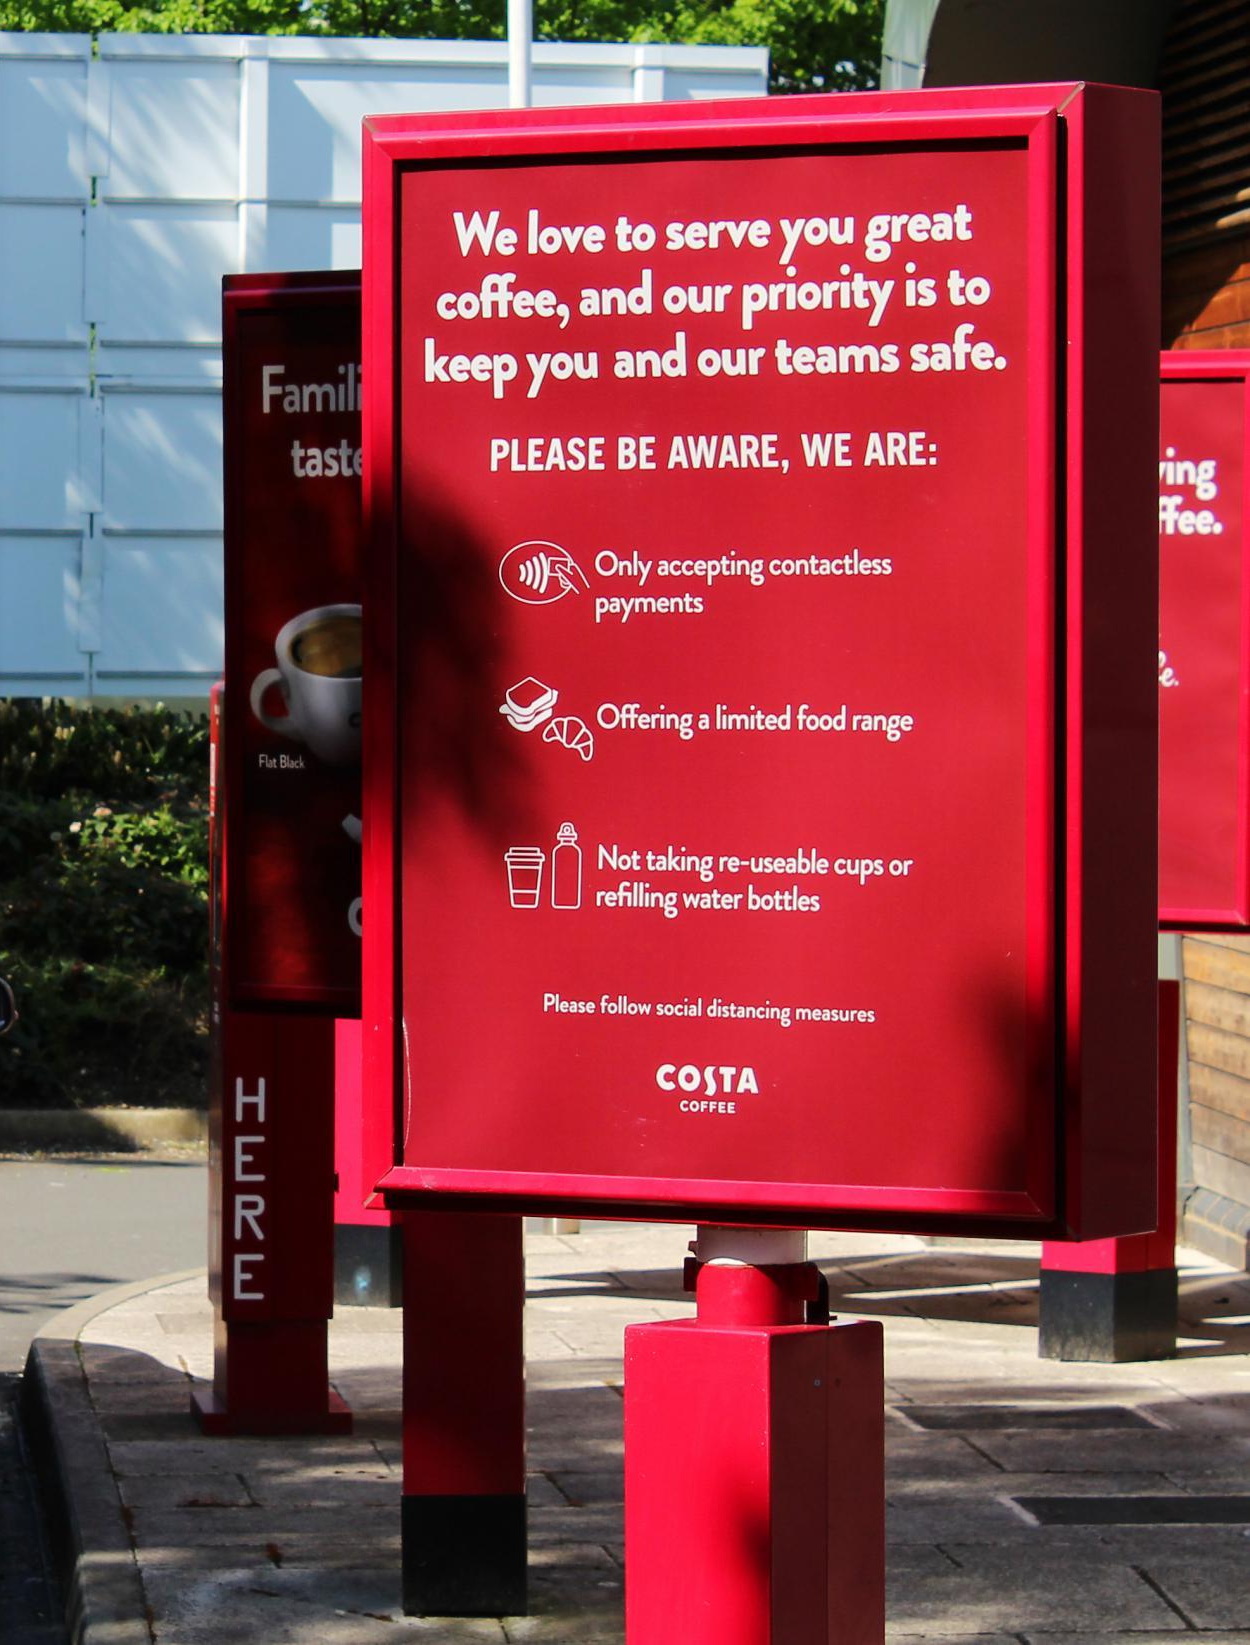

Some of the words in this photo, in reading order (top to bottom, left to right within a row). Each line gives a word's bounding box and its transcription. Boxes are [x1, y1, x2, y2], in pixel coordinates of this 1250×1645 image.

[452, 210, 518, 257] We
[527, 209, 607, 255] love
[614, 216, 657, 252] to
[665, 219, 772, 251] serve
[779, 215, 855, 265] you
[865, 204, 973, 262] great
[436, 272, 570, 329] coffee,
[579, 268, 653, 317] and
[662, 284, 734, 314] our
[742, 265, 895, 330] priority
[904, 261, 938, 307] is
[946, 269, 991, 306] to
[424, 337, 518, 399] keep
[525, 351, 599, 399] you
[613, 331, 687, 379] and
[697, 347, 767, 377] our
[774, 339, 900, 375] teams
[909, 322, 1007, 372] safe.
[490, 437, 606, 472] PLEASE
[617, 436, 657, 470] BE
[667, 434, 790, 474] AWARE,
[800, 432, 853, 467] WE
[863, 431, 937, 467] ARE:
[594, 550, 653, 586] Only
[657, 550, 765, 586] accepting
[768, 548, 893, 576] contactless
[595, 592, 704, 623] payments
[596, 703, 694, 740] Offering
[697, 713, 710, 730] a
[715, 703, 792, 731] limited
[796, 703, 847, 731] food
[852, 714, 914, 742] range
[258, 753, 277, 769] Flat
[280, 754, 306, 769] Black
[597, 843, 641, 871] Not
[645, 845, 714, 883] taking
[718, 847, 830, 875] re-useable
[833, 858, 885, 886] cups
[888, 859, 914, 876] or
[596, 881, 679, 919] refilling
[683, 890, 743, 910] water
[747, 884, 821, 912] bottles
[543, 992, 596, 1014] Please
[599, 994, 652, 1016] follow
[656, 997, 703, 1017] social
[706, 998, 792, 1028] distancing
[795, 1007, 876, 1023] measures
[655, 1063, 759, 1097] COSTA
[679, 1099, 736, 1114] COFFEE
[234, 1076, 266, 1300] HERE
